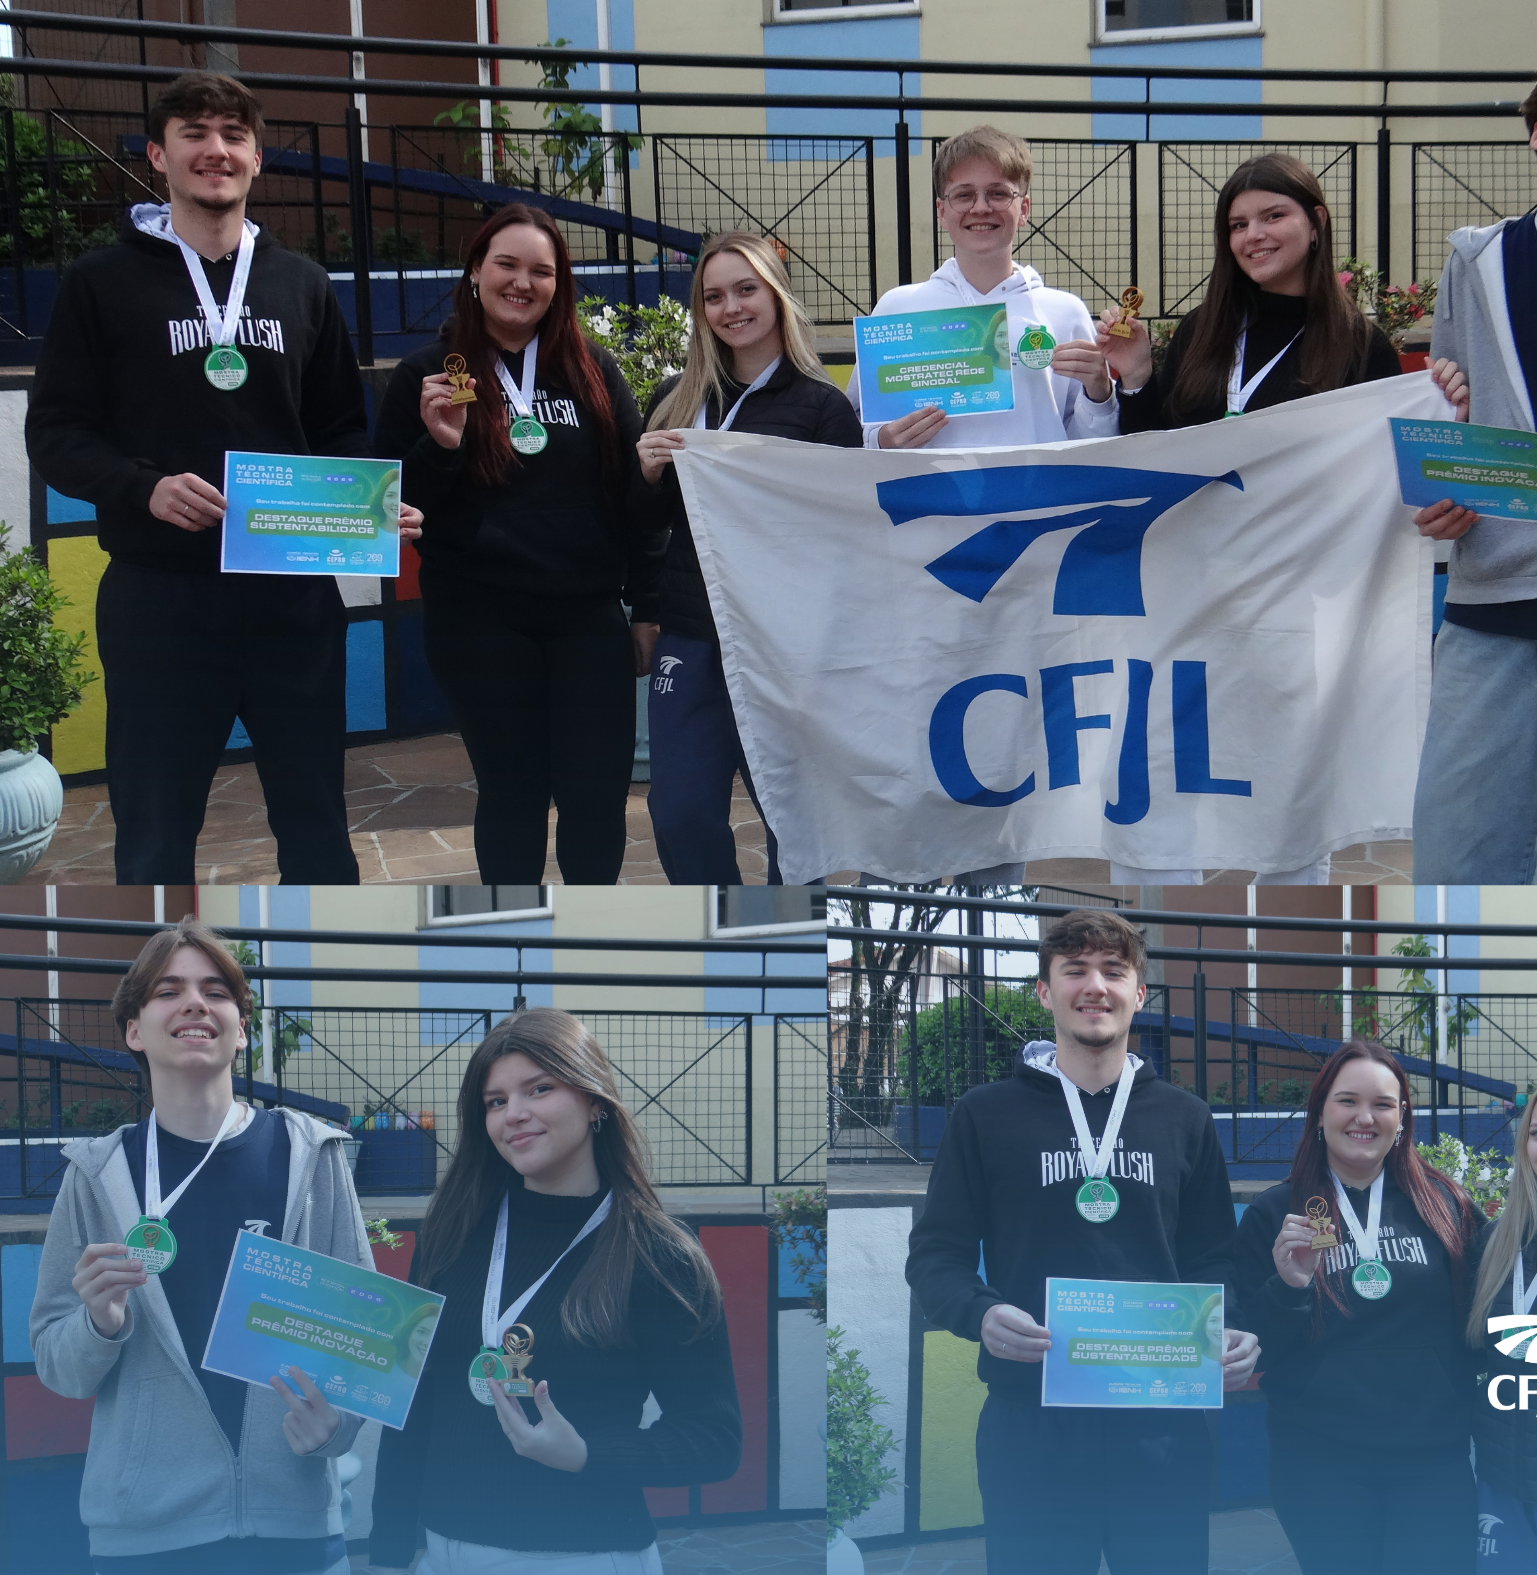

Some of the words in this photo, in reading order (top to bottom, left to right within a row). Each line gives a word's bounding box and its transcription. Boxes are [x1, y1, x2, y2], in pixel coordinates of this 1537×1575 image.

[863, 322, 913, 333] MOSTRA
[864, 328, 913, 339] TÉCNICO
[168, 319, 215, 356] ROYA
[239, 319, 284, 354] LUSH
[864, 334, 913, 345] CIENTÍFICA
[900, 361, 969, 374] CREDENCIAL
[885, 370, 954, 383] MOSTRATEC
[956, 367, 986, 376] REDE
[911, 377, 960, 388] SINODAL
[1400, 426, 1463, 435] MOSTRA
[1401, 431, 1463, 440] TÉCNICO
[1402, 436, 1464, 445] CIENTÍFICA
[235, 464, 293, 473] MOSTRA
[1454, 466, 1529, 479] DESTAQUE
[235, 470, 293, 480] TÉCNICO
[1426, 469, 1479, 481] PRÊMIO
[235, 477, 293, 487] CIENTÍFICA
[255, 513, 323, 524] DESTAQUE
[325, 516, 373, 526] PRÊMIO
[250, 522, 375, 535] SUSTENTABILIDADE
[654, 677, 674, 694] CFJL
[929, 658, 1252, 825] CFJL
[1041, 1151, 1087, 1187] ROYA
[1110, 1151, 1154, 1186] LUSH
[133, 1248, 165, 1256] MOSTRA
[247, 1246, 313, 1273] MOSTRA
[245, 1254, 312, 1280] TÉCNICO
[243, 1263, 309, 1289] CIENTÍFICA
[1057, 1290, 1115, 1300] MOSTRA
[1057, 1297, 1115, 1307] TÉCNICO
[1057, 1304, 1115, 1314] CIENTÍFICA
[260, 1293, 277, 1302] Seu
[278, 1299, 312, 1313] trabalho
[312, 1308, 324, 1316] foi
[324, 1314, 376, 1334] contemplado
[376, 1330, 394, 1340] com
[284, 1316, 364, 1348] DESTAQUE
[251, 1316, 308, 1340] PRÊMIO
[310, 1334, 388, 1367] INOVAÇÃO
[1076, 1342, 1145, 1353] DESTAQUE
[1147, 1344, 1196, 1354] PRÊMIO
[1072, 1351, 1198, 1362] SUSTENTABILIDADE
